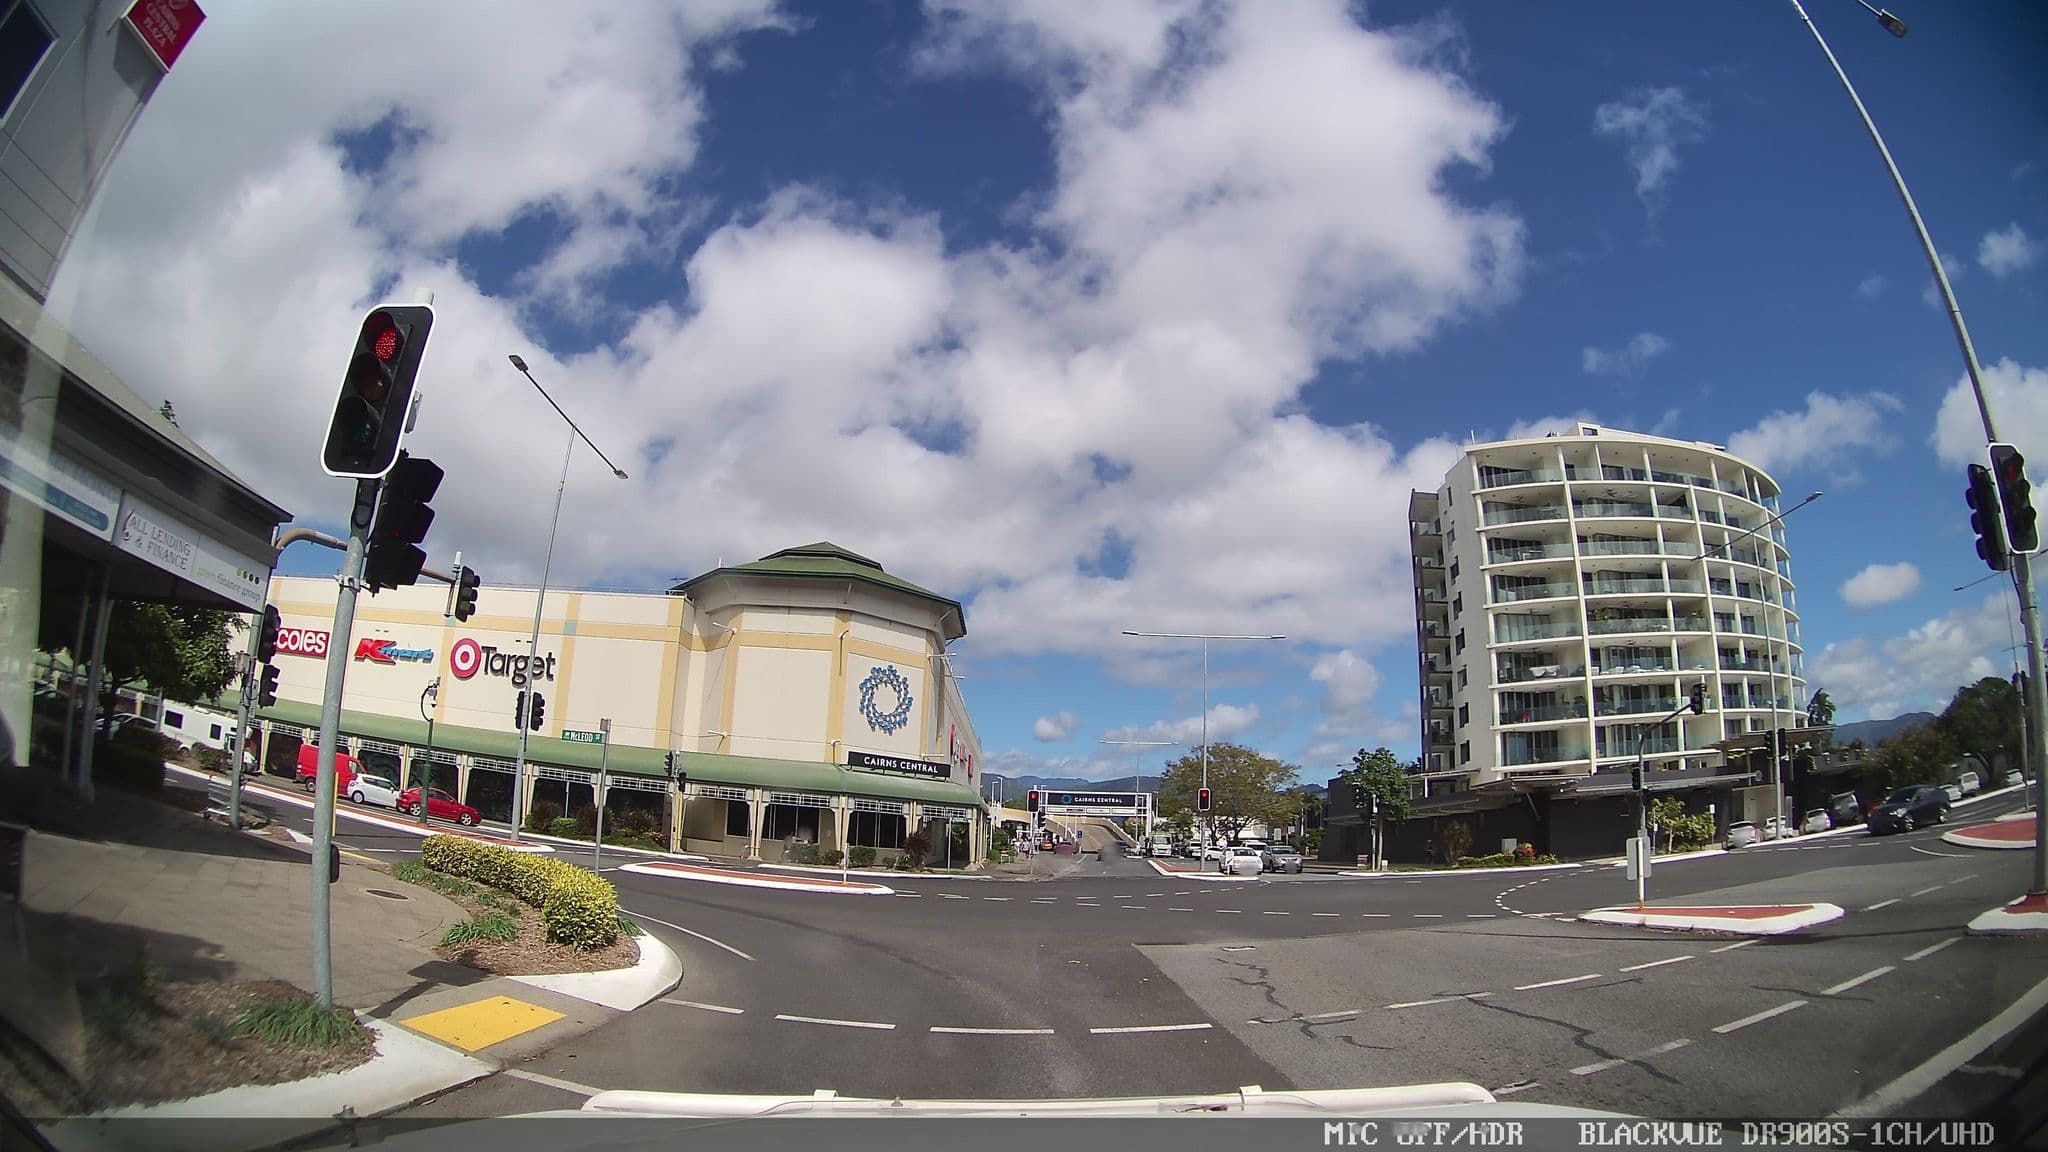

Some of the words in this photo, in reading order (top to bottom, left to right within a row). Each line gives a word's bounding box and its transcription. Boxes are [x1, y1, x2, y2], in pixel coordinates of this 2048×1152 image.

[128, 516, 148, 535] ALL
[151, 525, 193, 556] LENDING
[147, 541, 188, 570] FINANCE
[277, 630, 326, 653] coles
[355, 638, 434, 665] Kmart
[481, 646, 556, 687] Target
[864, 756, 897, 768] CAIRNS
[900, 761, 938, 773] CENTRAL
